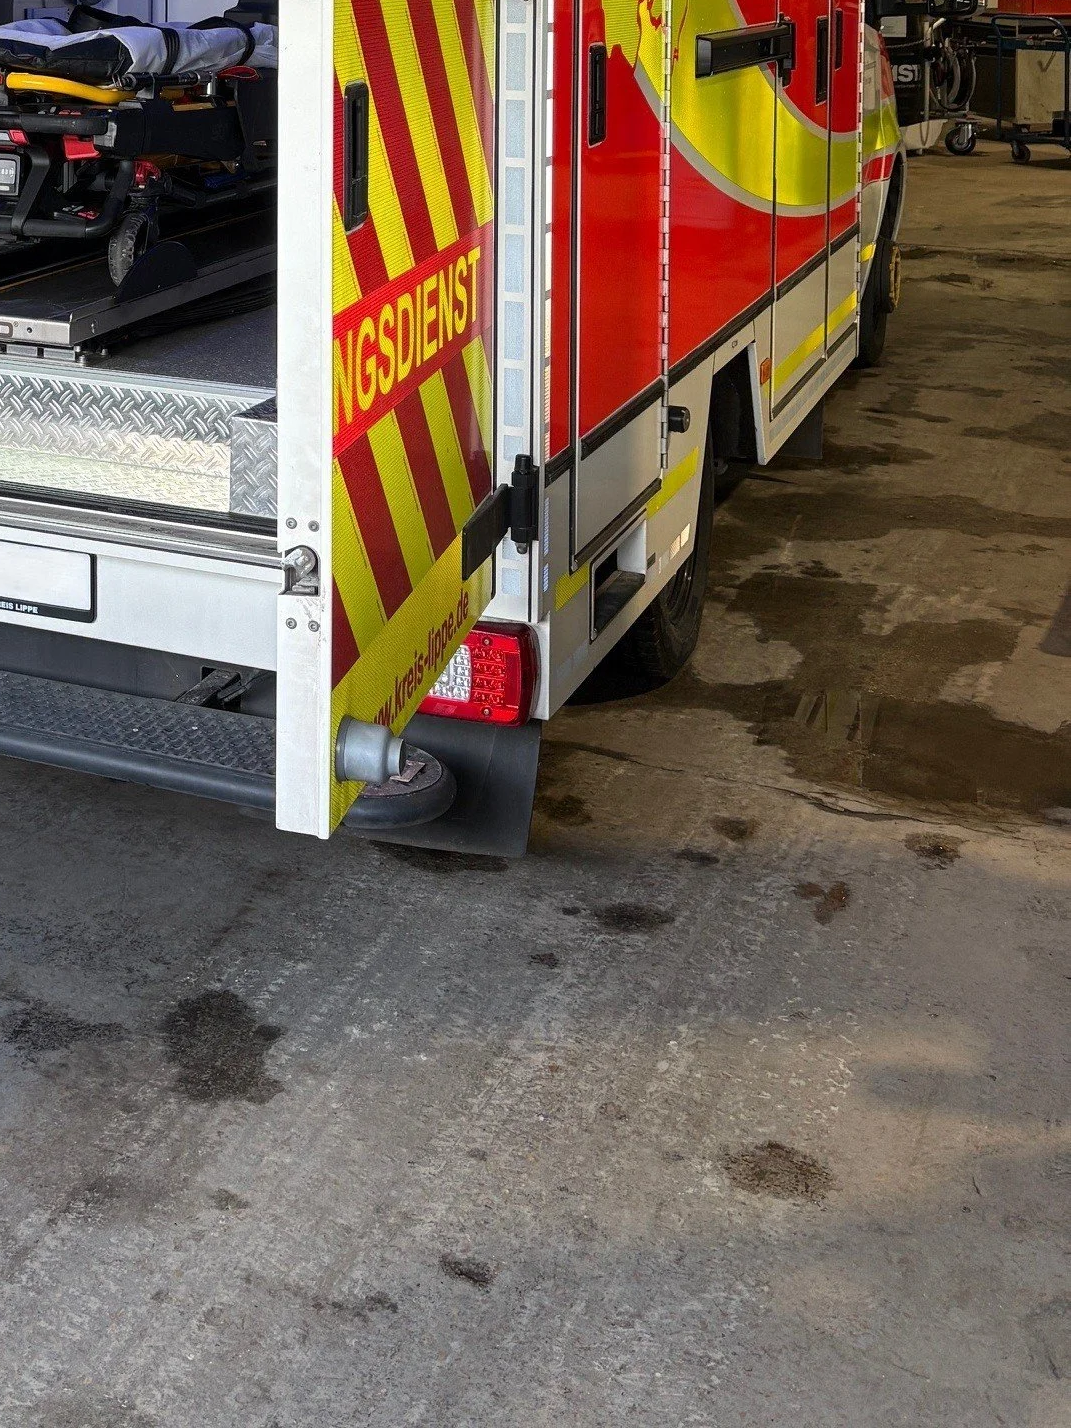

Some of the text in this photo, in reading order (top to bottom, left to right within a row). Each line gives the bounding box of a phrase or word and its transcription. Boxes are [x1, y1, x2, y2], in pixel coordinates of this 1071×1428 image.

[333, 245, 481, 436] NGSDIENST
[15, 602, 39, 614] LIPPE
[371, 587, 470, 727] w.kreis-lippe.de
